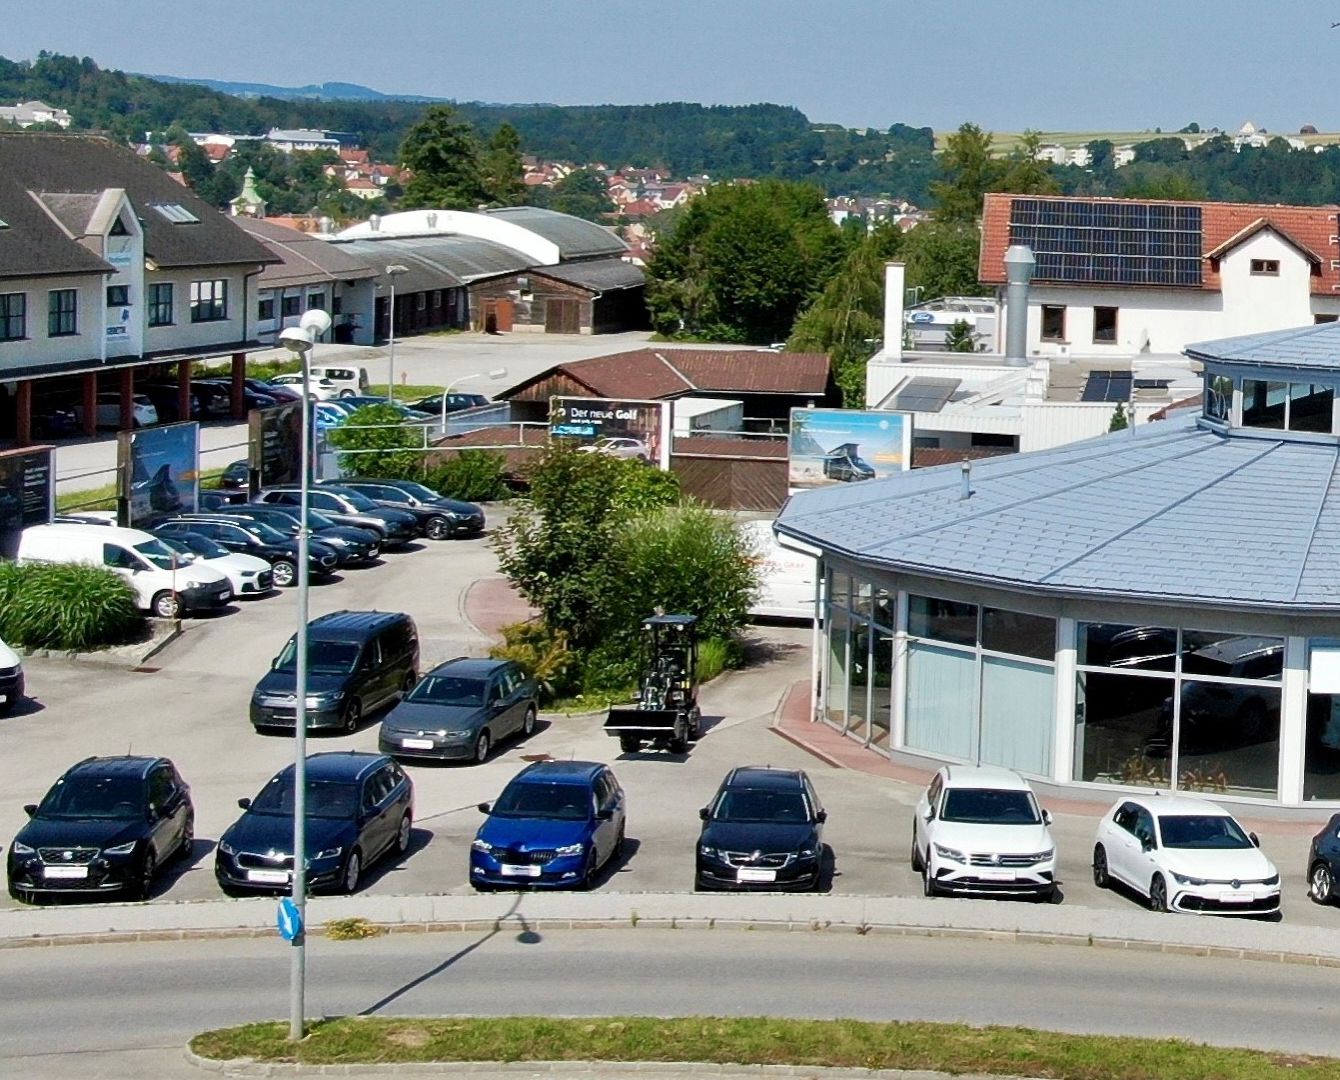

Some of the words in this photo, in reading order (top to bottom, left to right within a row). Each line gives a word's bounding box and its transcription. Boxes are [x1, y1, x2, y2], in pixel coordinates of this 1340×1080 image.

[570, 407, 588, 418] Der
[589, 410, 613, 419] neue
[615, 409, 638, 420] Golf
